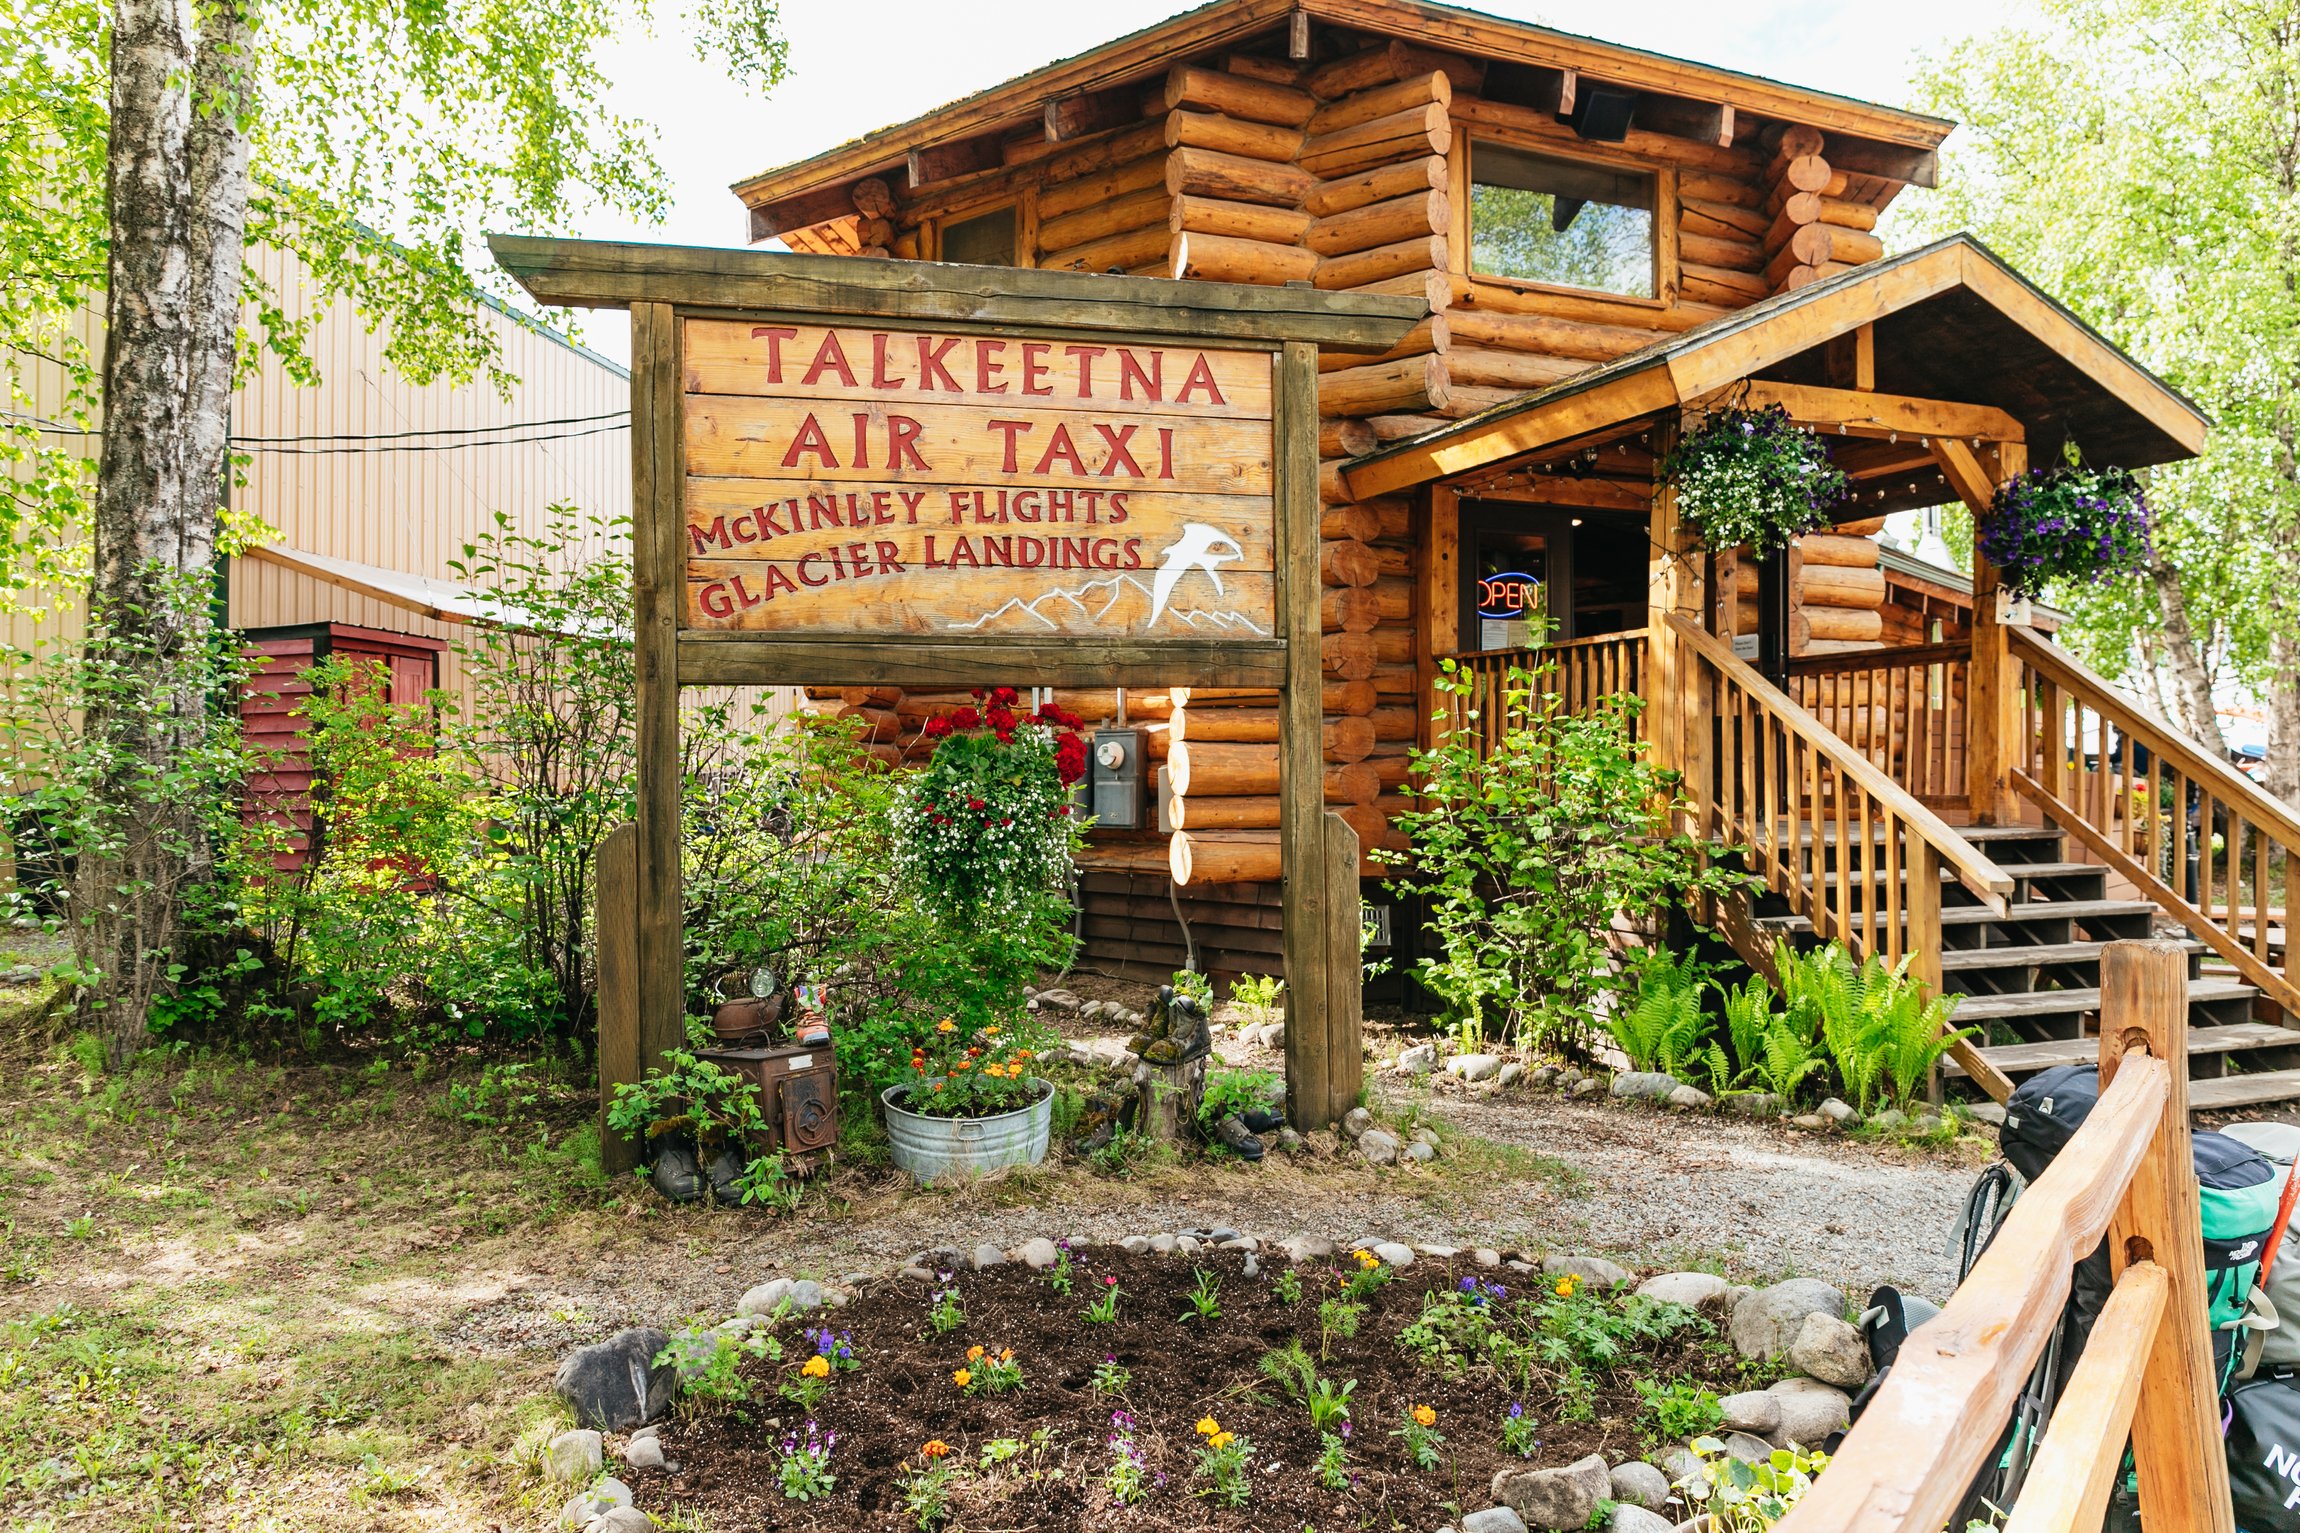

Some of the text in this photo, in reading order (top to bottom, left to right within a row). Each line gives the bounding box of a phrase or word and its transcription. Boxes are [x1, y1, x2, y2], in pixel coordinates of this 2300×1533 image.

[752, 327, 1226, 405] TALKEETNA
[781, 412, 1175, 479] AIR TAXI
[949, 490, 1129, 524] FLIGHTS
[699, 535, 1141, 619] GLACIER LANDINGS
[1478, 580, 1538, 609] OPEN
